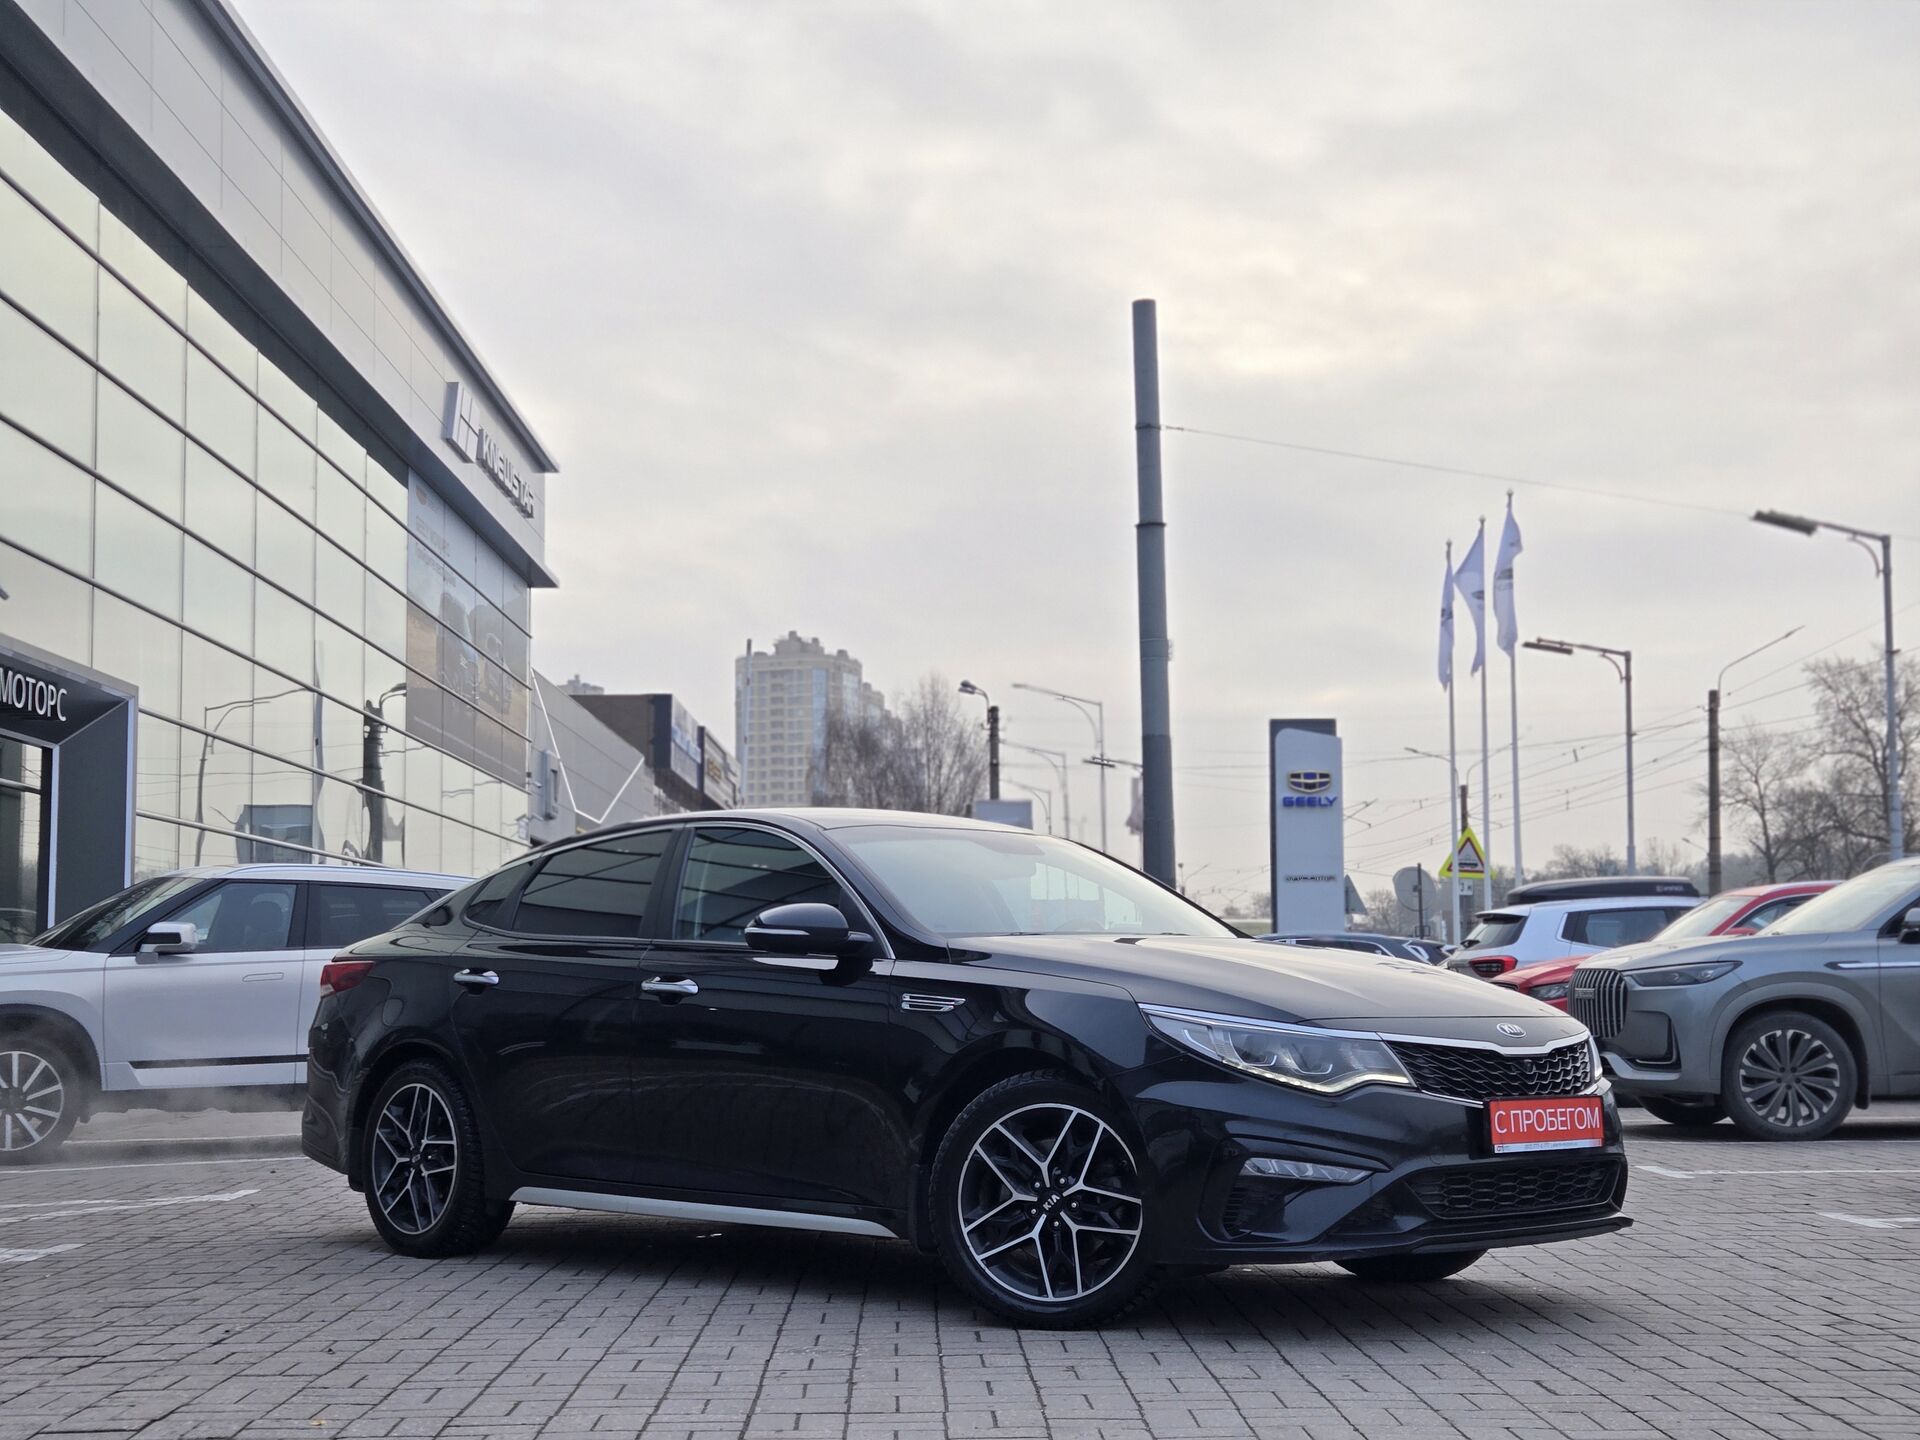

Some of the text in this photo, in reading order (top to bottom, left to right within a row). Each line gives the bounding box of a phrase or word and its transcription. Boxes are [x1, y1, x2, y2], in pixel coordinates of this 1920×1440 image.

[0, 667, 68, 722] МОТОРС
[1282, 796, 1338, 808] GEELY
[1494, 1106, 1600, 1134] С ПРОБЕГОМ
[1043, 1194, 1060, 1211] KIA
